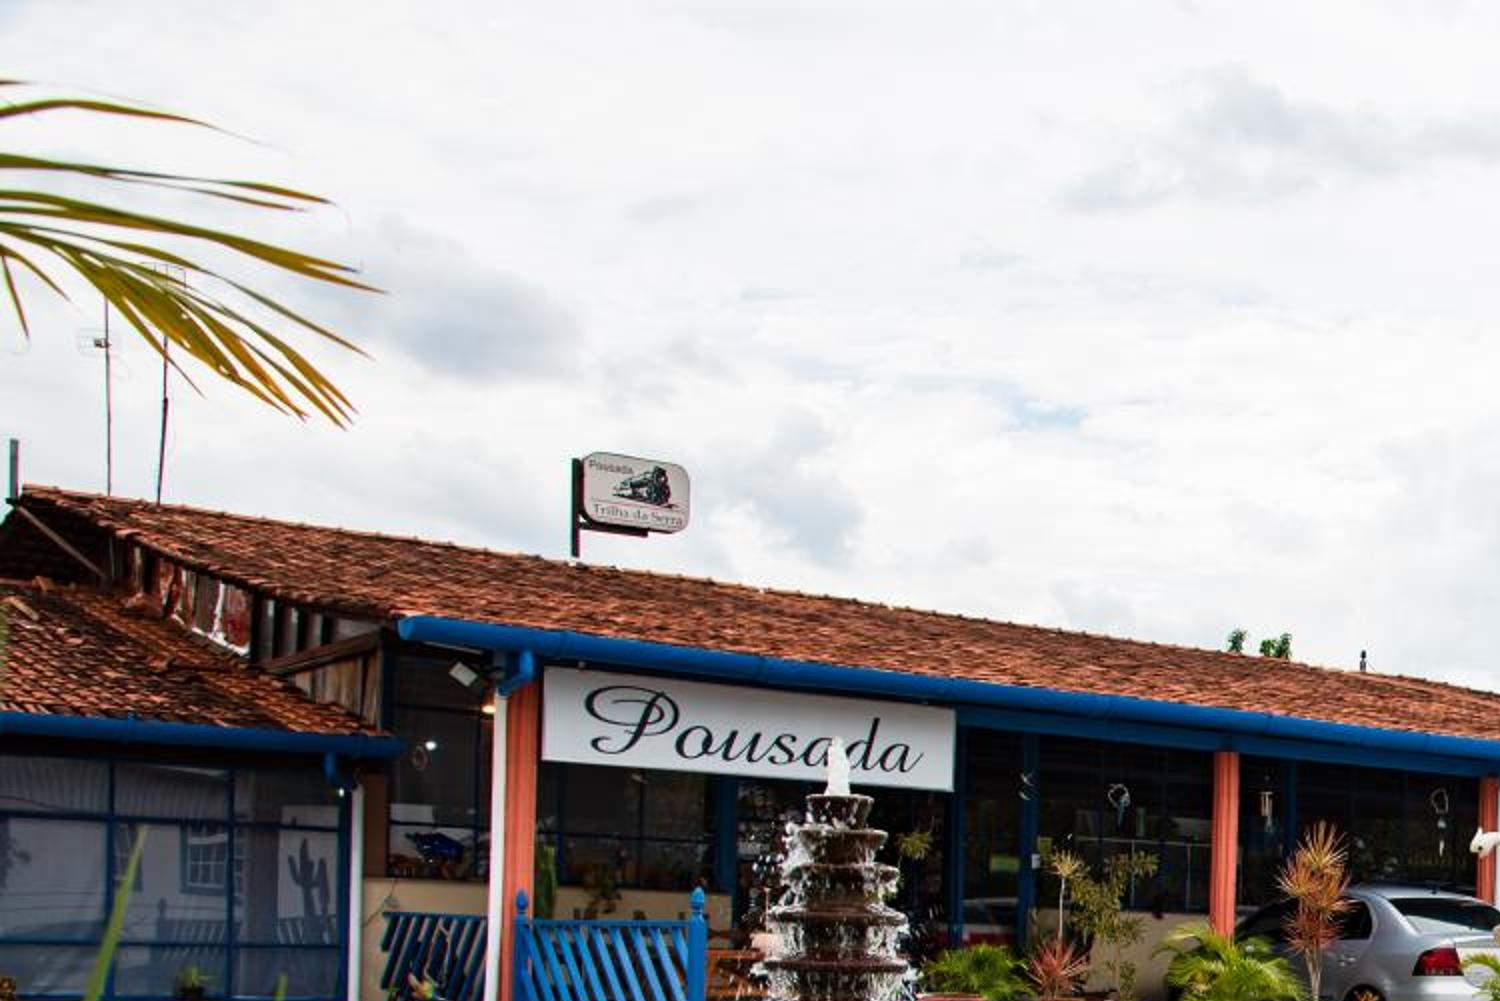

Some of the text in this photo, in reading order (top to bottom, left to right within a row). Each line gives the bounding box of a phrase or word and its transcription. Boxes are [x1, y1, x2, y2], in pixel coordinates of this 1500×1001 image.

[631, 508, 650, 521] da
[650, 511, 683, 527] Serra
[584, 685, 924, 773] Pousada
